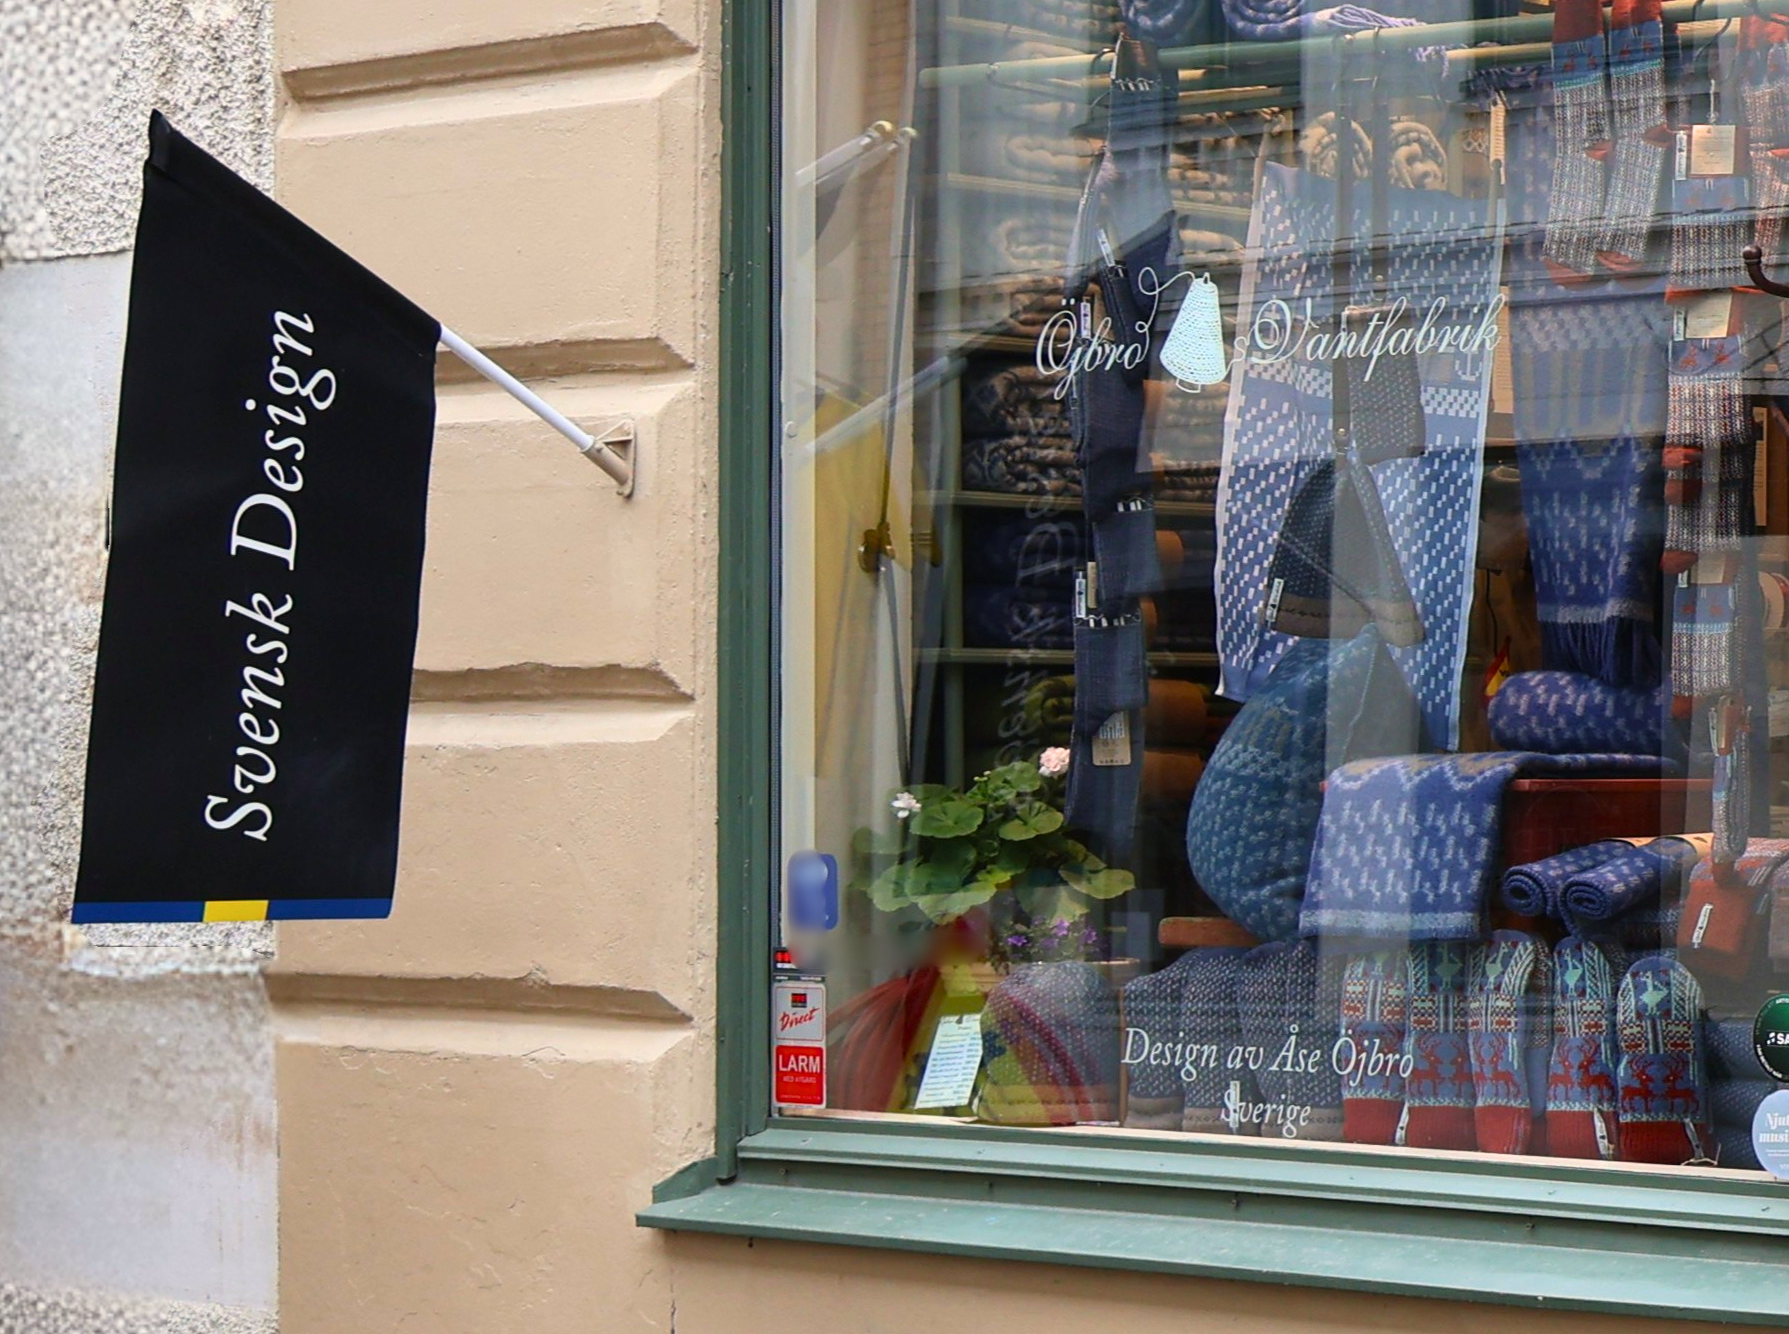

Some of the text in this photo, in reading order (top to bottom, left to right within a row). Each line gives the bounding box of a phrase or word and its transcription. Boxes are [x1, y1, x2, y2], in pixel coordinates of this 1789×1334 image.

[1036, 294, 1507, 400] Öjbro Vantfabrik
[205, 310, 337, 842] Svensk Design
[780, 1007, 820, 1032] Direct
[779, 1055, 820, 1073] LARM
[1121, 1024, 1414, 1087] Design av Åse Öjbro
[1220, 1090, 1311, 1138] Sverige
